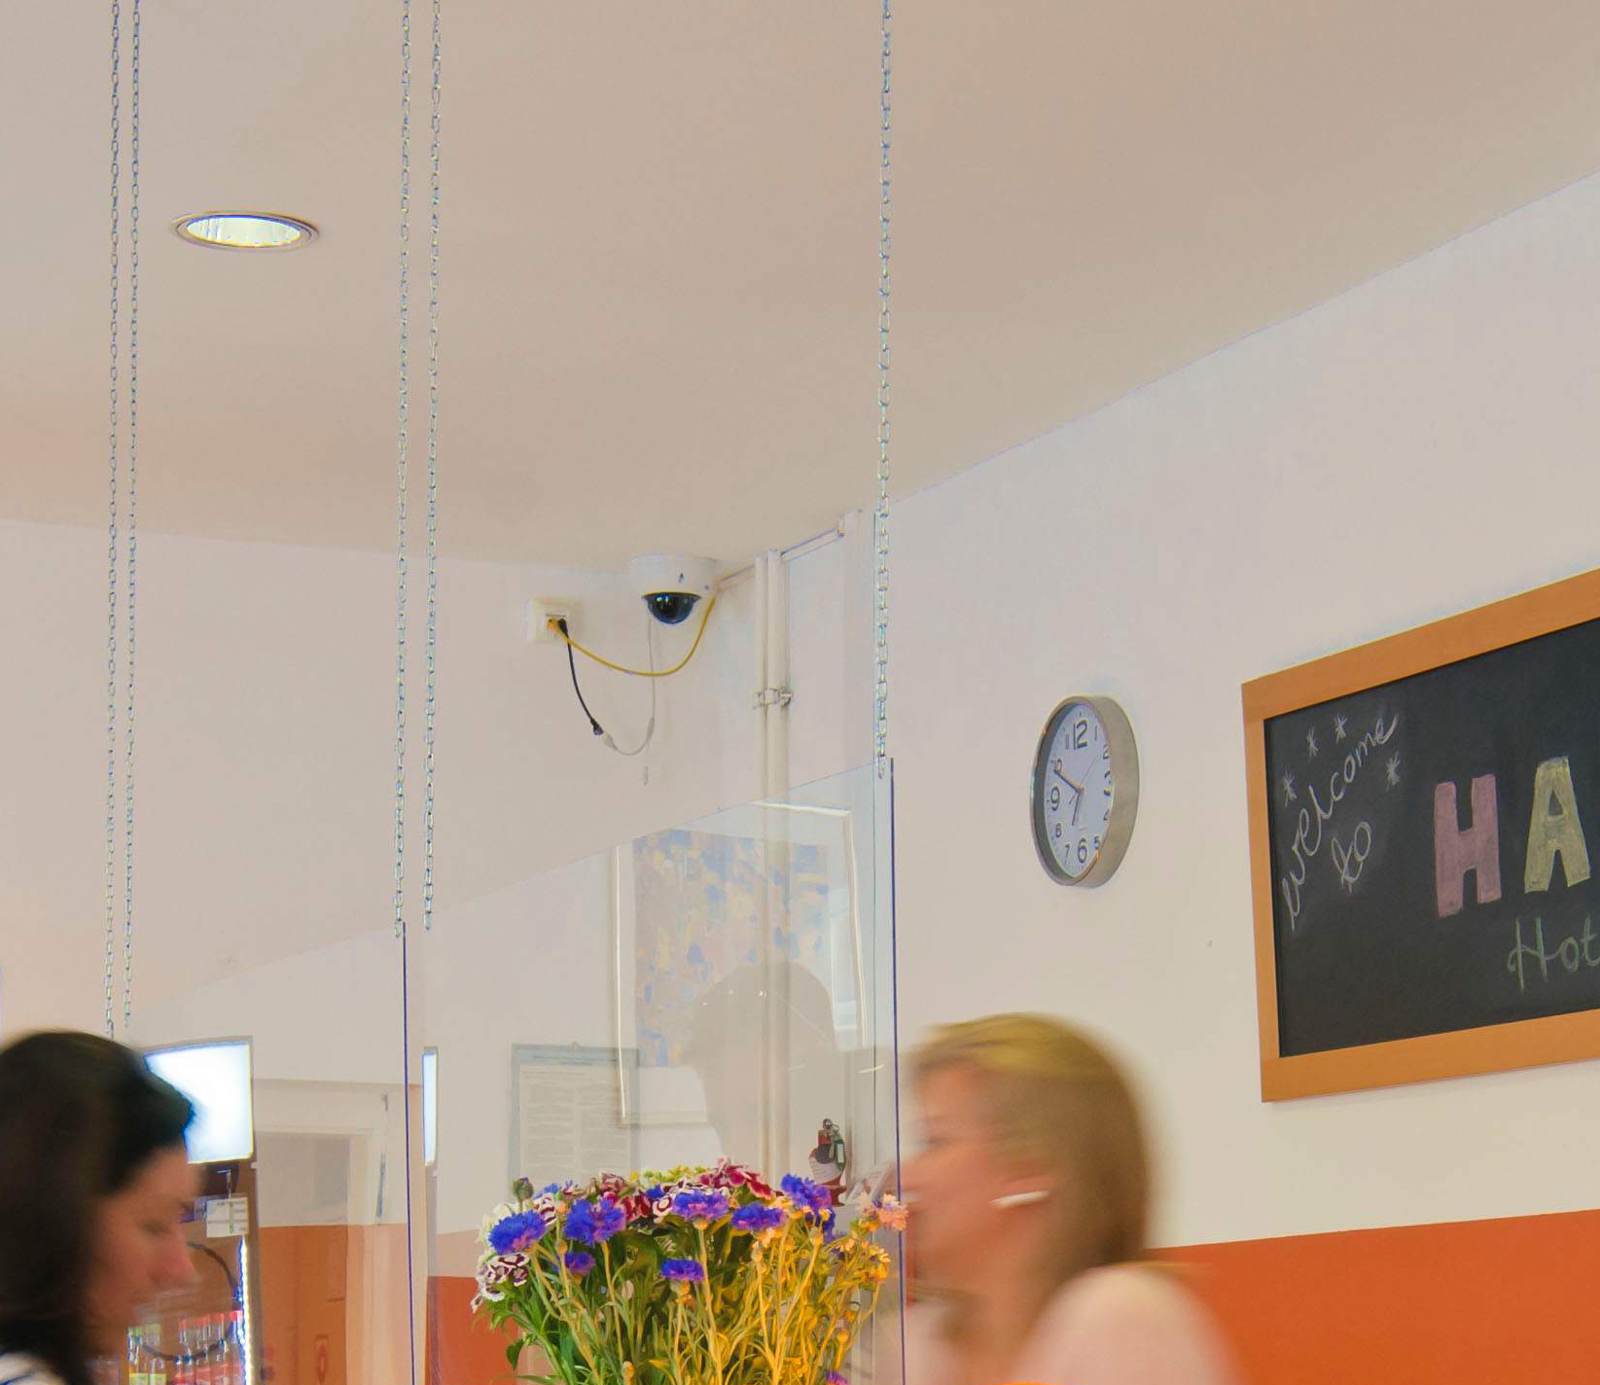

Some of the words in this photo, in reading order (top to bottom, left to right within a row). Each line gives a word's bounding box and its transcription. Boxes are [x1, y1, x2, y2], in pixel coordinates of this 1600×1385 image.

[1073, 719, 1088, 750] 12
[1050, 785, 1061, 811] 9
[1076, 837, 1088, 864] 6
[1330, 821, 1372, 895] to
